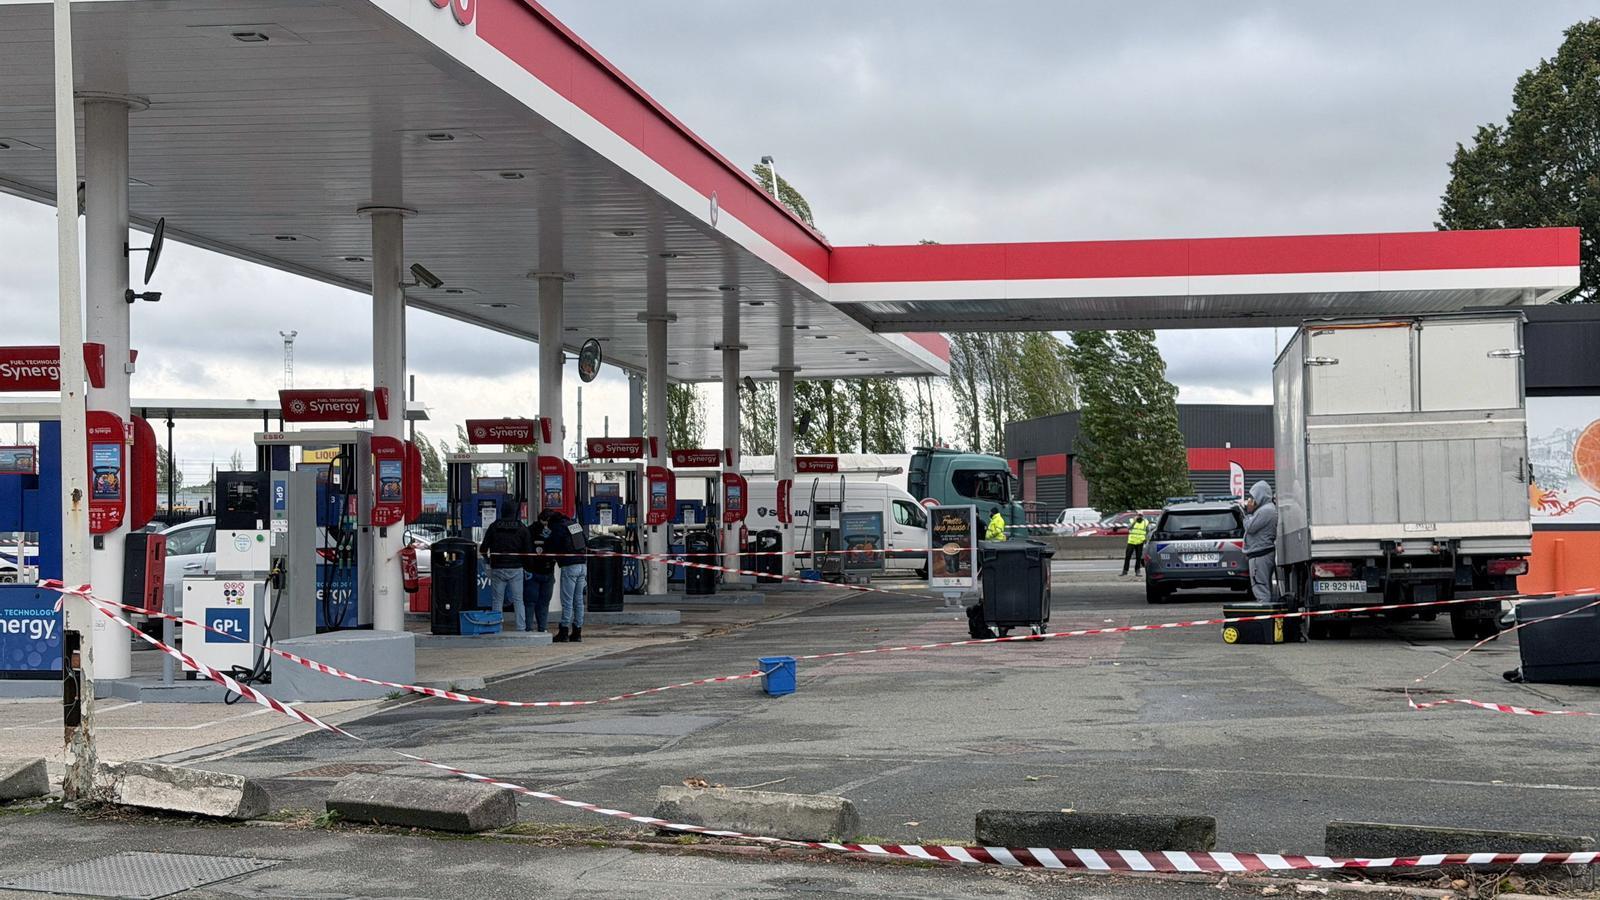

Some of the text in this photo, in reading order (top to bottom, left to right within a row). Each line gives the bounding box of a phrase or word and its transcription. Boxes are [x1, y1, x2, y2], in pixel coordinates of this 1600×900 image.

[99, 354, 104, 369] 1
[310, 401, 360, 414] Synergy
[489, 427, 529, 439] Synergy
[606, 444, 640, 453] Synergy
[687, 455, 717, 463] Synergy
[276, 486, 284, 503] GPL
[768, 509, 809, 517] SNIA
[0, 619, 56, 639] nergy
[212, 619, 243, 633] GPL
